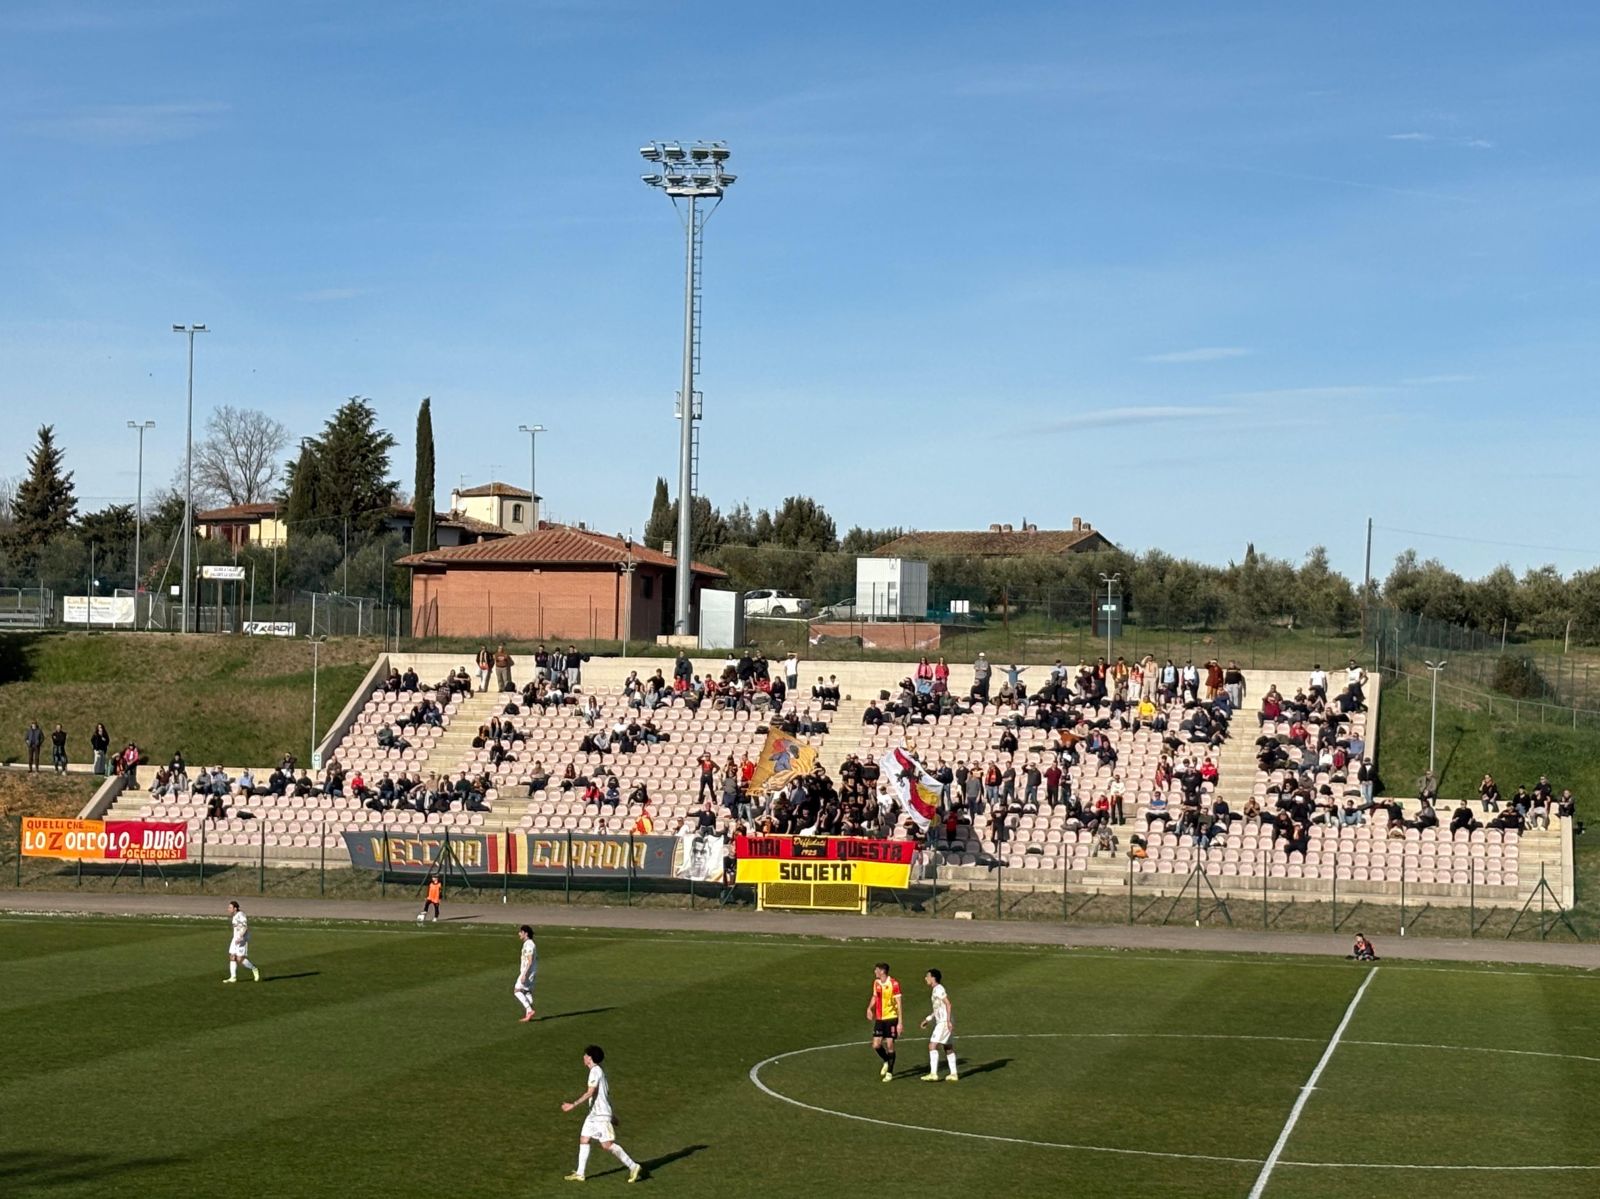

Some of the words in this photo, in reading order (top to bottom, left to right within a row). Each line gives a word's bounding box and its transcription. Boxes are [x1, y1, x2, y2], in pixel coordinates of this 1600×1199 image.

[27, 820, 64, 829] QUELLI
[25, 831, 46, 849] LO
[142, 829, 185, 850] DURO
[748, 838, 780, 856] MAI
[837, 840, 902, 861] QUESTA
[120, 848, 180, 859] POGGIBONSI
[532, 840, 648, 869] GUARDIA
